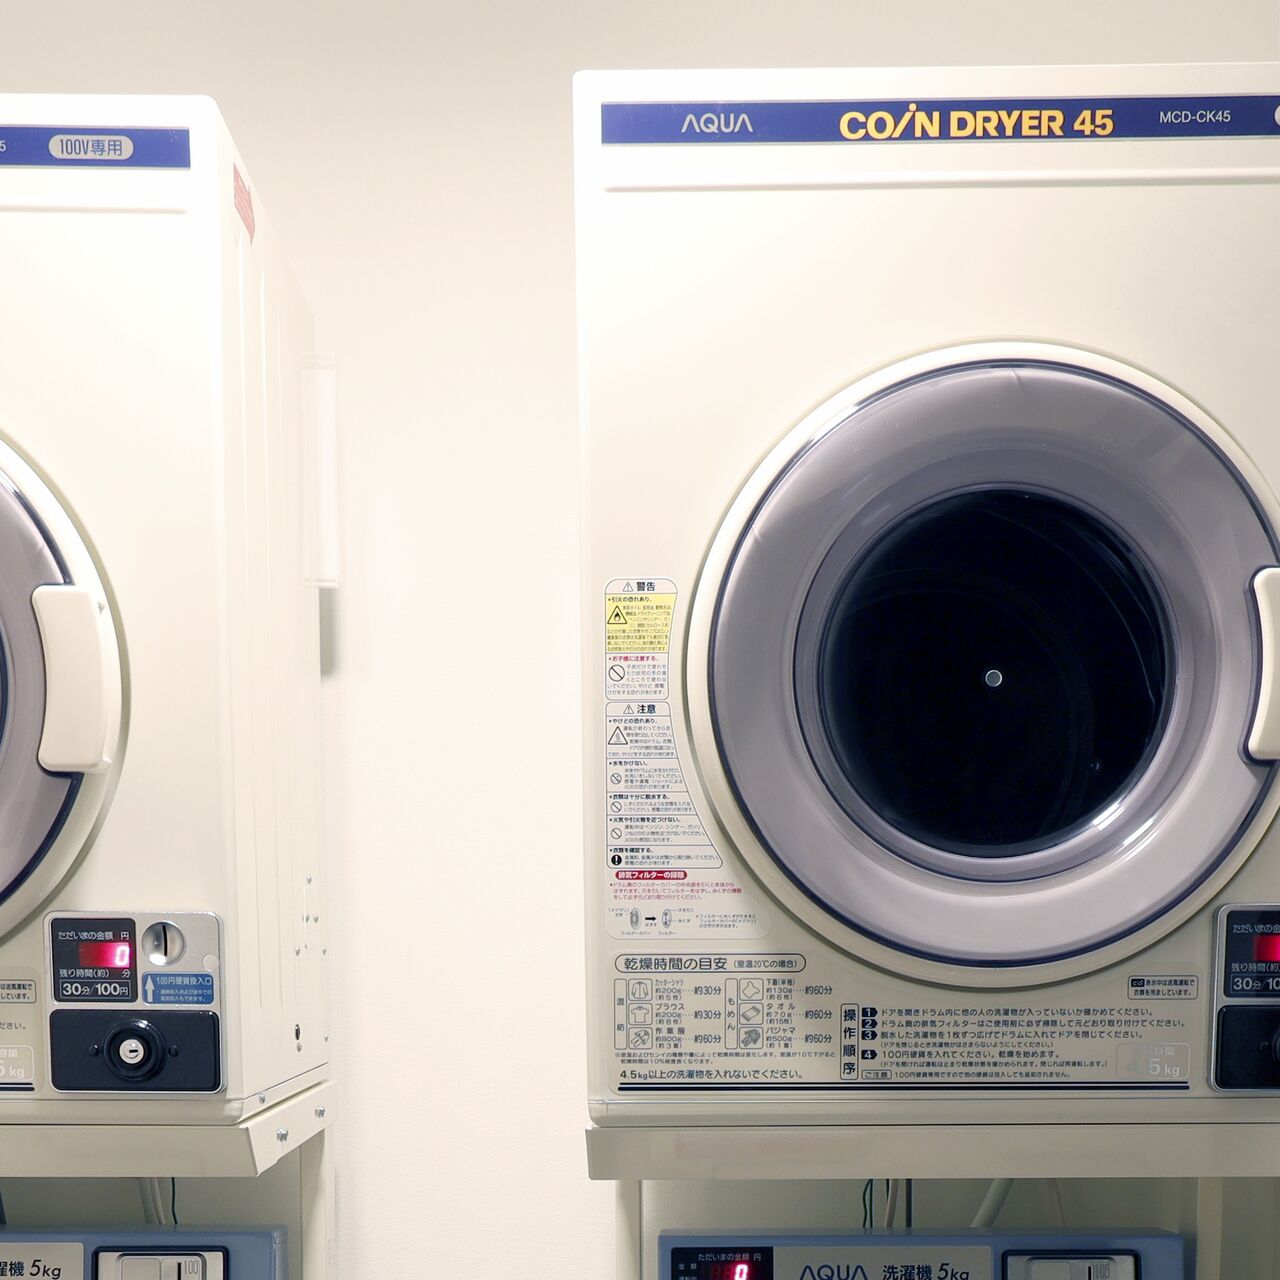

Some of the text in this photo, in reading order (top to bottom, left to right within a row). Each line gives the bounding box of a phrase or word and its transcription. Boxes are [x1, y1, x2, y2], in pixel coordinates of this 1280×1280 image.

[681, 113, 753, 133] AQUA
[950, 110, 1065, 138] DRYER
[1073, 109, 1113, 136] 45
[1159, 109, 1231, 125] MCD-CK45
[59, 137, 124, 158] 100V専用
[637, 581, 655, 591] 警告
[637, 704, 656, 714] 注意
[121, 932, 130, 941] 円
[115, 945, 131, 966] 0
[624, 957, 728, 971] 乾燥時間の目安
[121, 970, 131, 979] 分
[843, 1009, 856, 1075] 操作順序
[10, 1066, 25, 1080] kg
[1163, 1063, 1180, 1078] kg
[753, 1253, 762, 1262] 円
[28, 1258, 62, 1280] 5kg
[882, 1264, 932, 1280] 洗濯機
